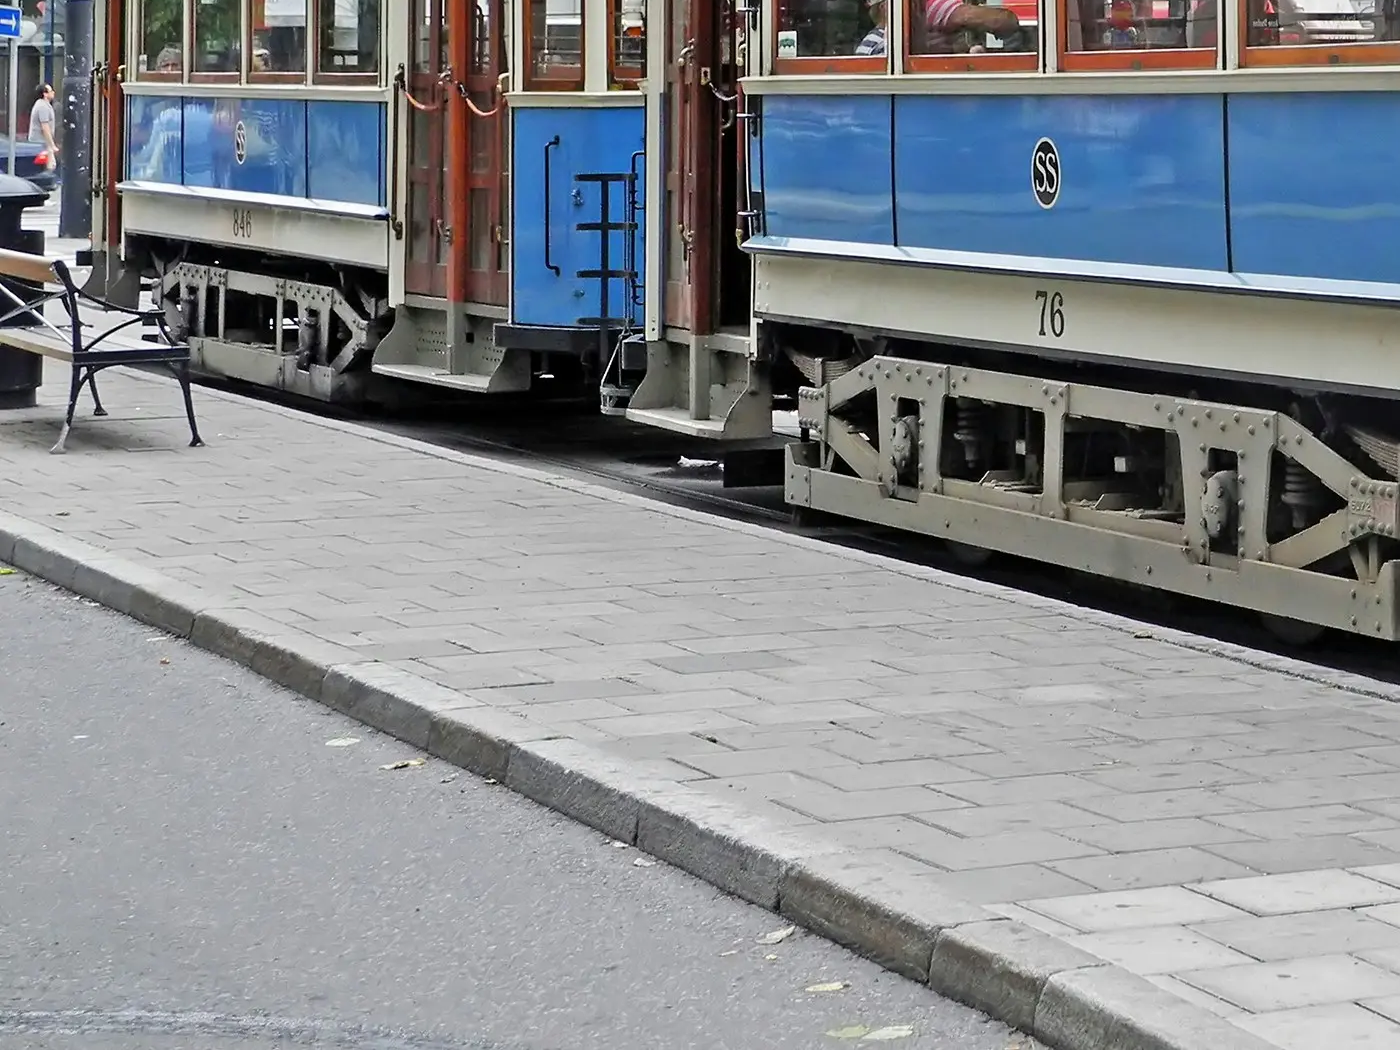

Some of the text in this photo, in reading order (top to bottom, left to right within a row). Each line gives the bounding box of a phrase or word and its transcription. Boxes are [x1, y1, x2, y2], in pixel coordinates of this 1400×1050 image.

[1035, 151, 1057, 194] SS
[233, 209, 252, 238] 846
[1035, 290, 1065, 338] 76
